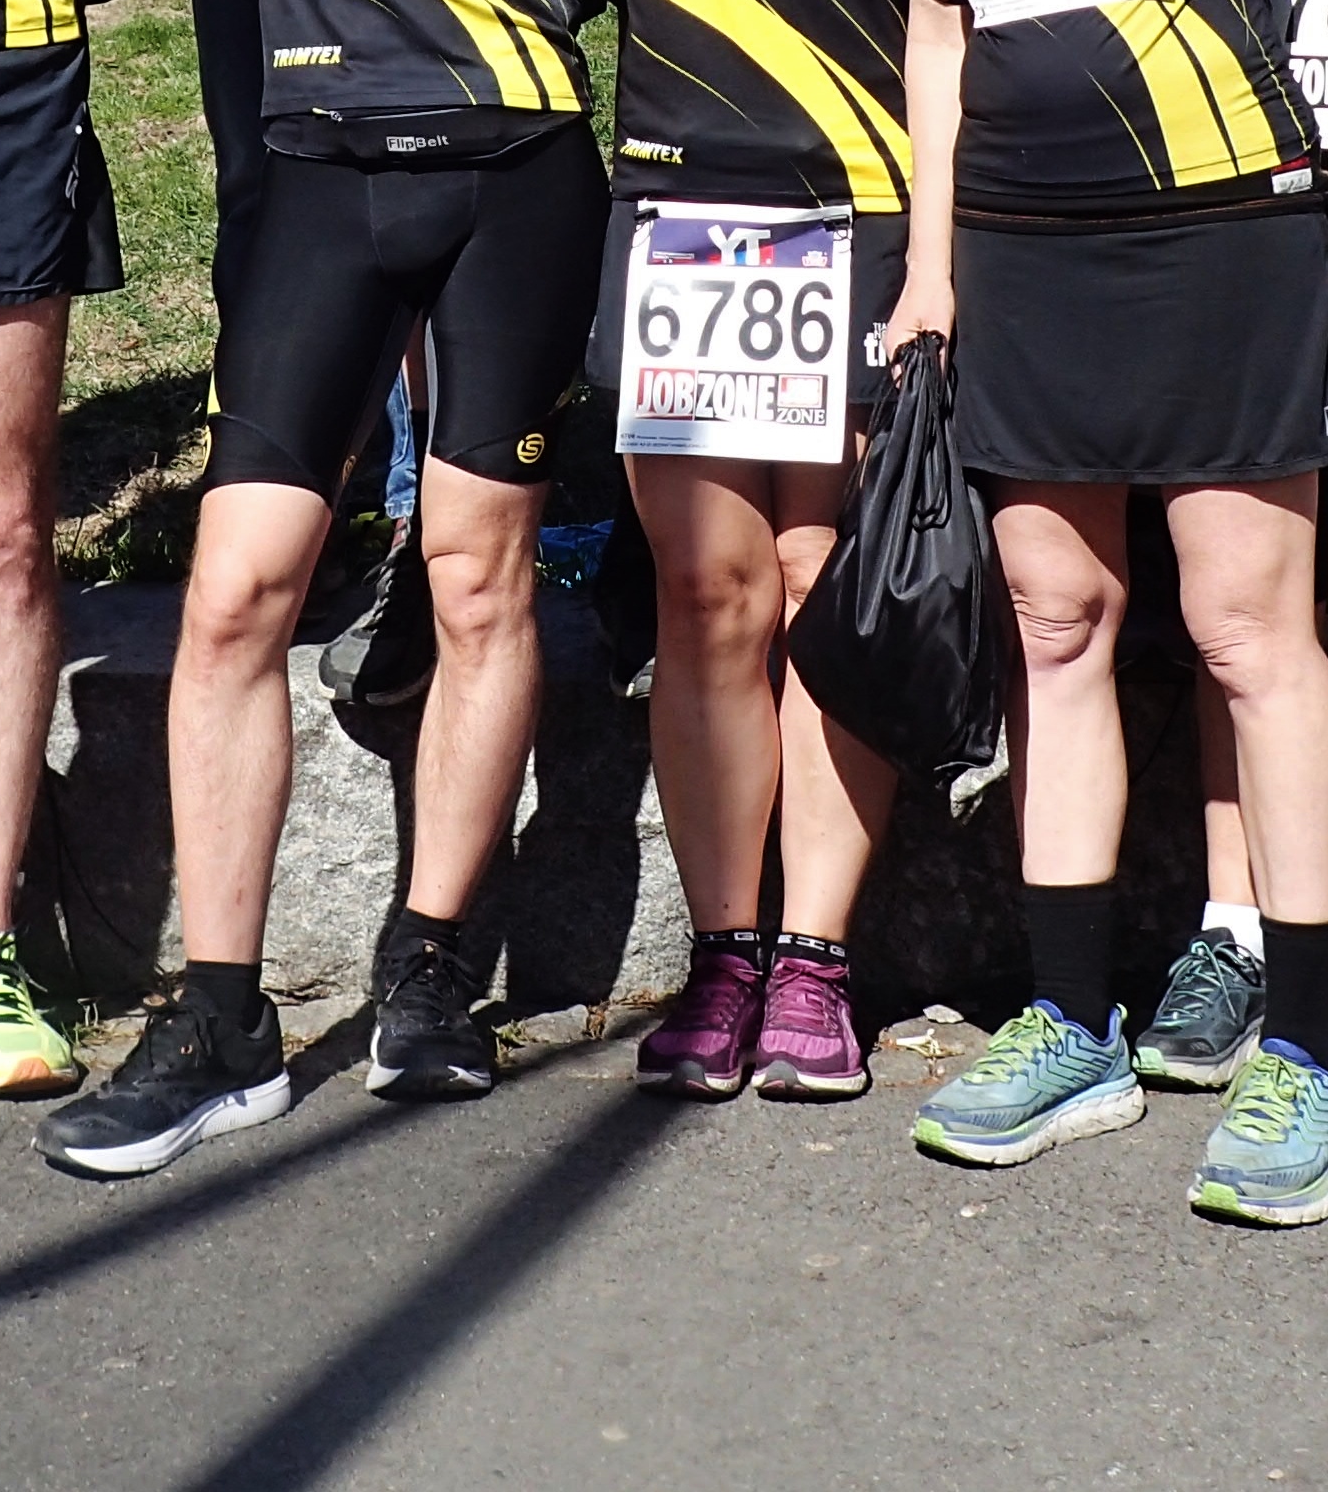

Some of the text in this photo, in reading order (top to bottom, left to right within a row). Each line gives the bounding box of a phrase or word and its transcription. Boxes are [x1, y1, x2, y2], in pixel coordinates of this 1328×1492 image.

[273, 45, 342, 68] TRIMTEX
[620, 138, 685, 164] TRIMTEX
[707, 224, 771, 266] YT
[638, 279, 834, 364] 6786
[777, 408, 826, 426] ZONE
